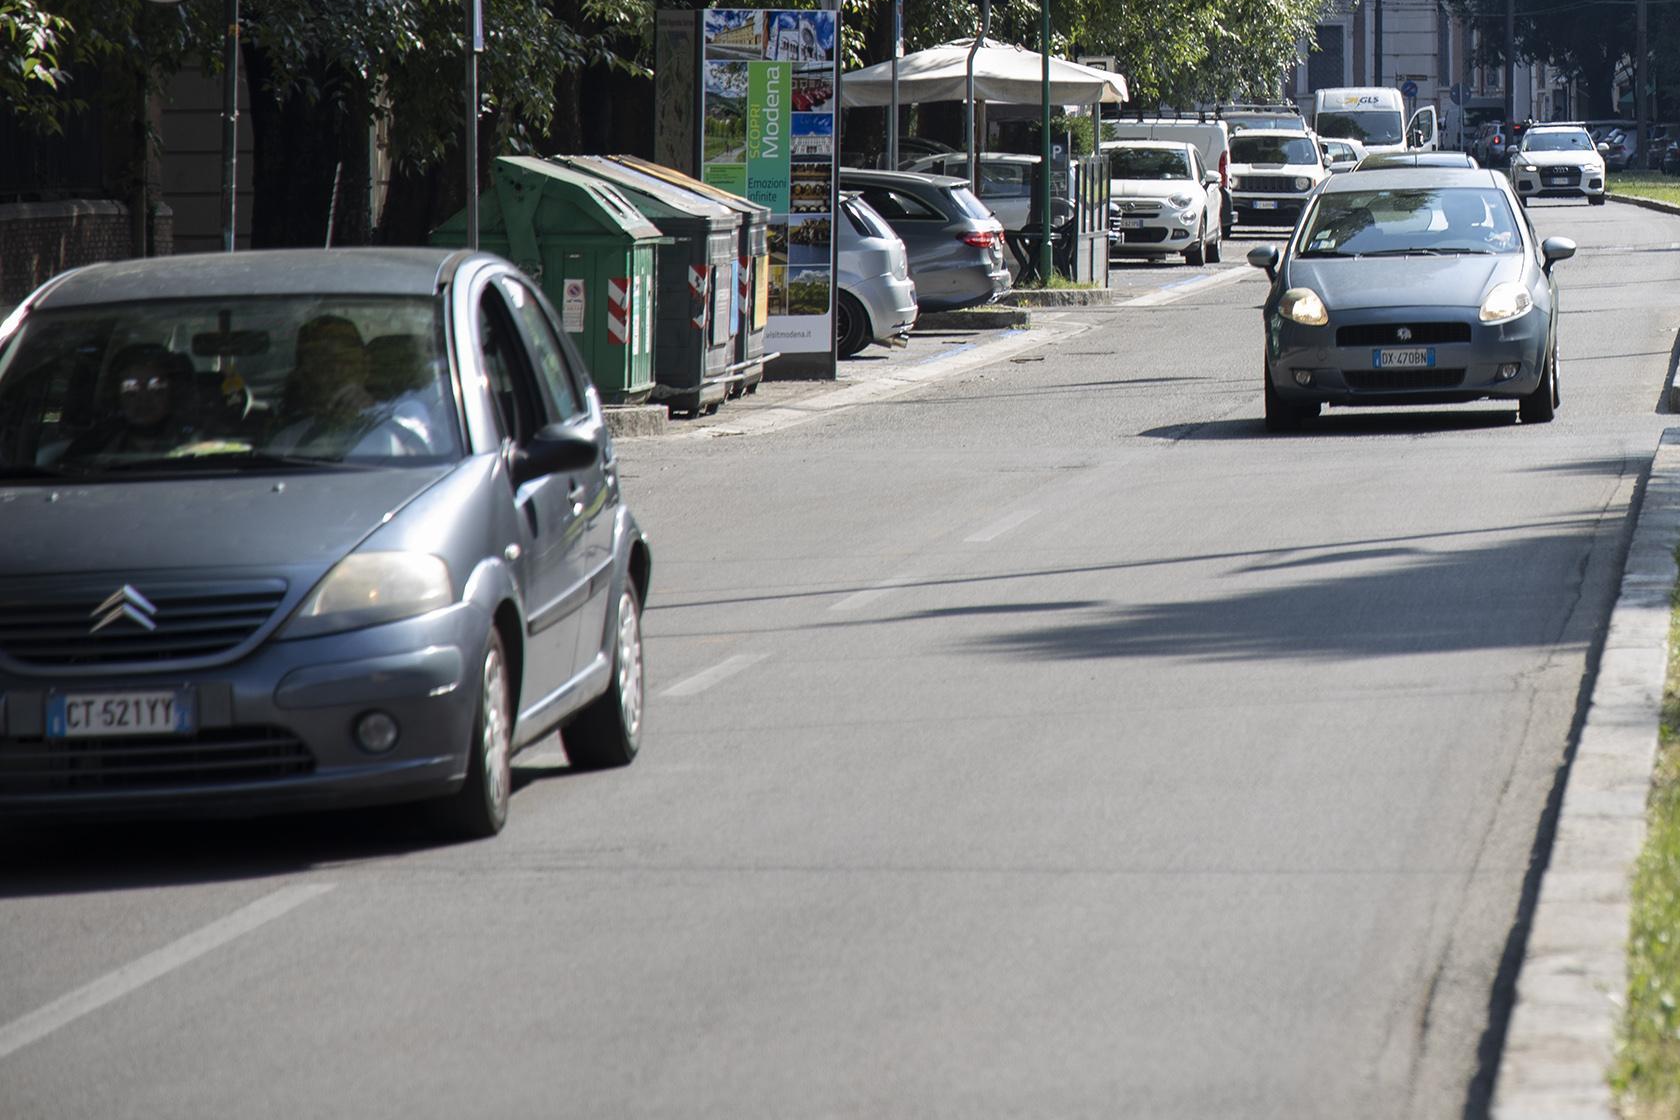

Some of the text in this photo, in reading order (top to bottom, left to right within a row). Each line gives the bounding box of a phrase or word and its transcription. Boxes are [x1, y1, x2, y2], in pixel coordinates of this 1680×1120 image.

[1359, 96, 1380, 104] GLS
[762, 65, 780, 159] Modena
[749, 103, 761, 160] SCOPRI
[747, 177, 788, 189] Emozioni
[747, 190, 777, 202] infinite
[66, 696, 174, 728] CT 521YY
